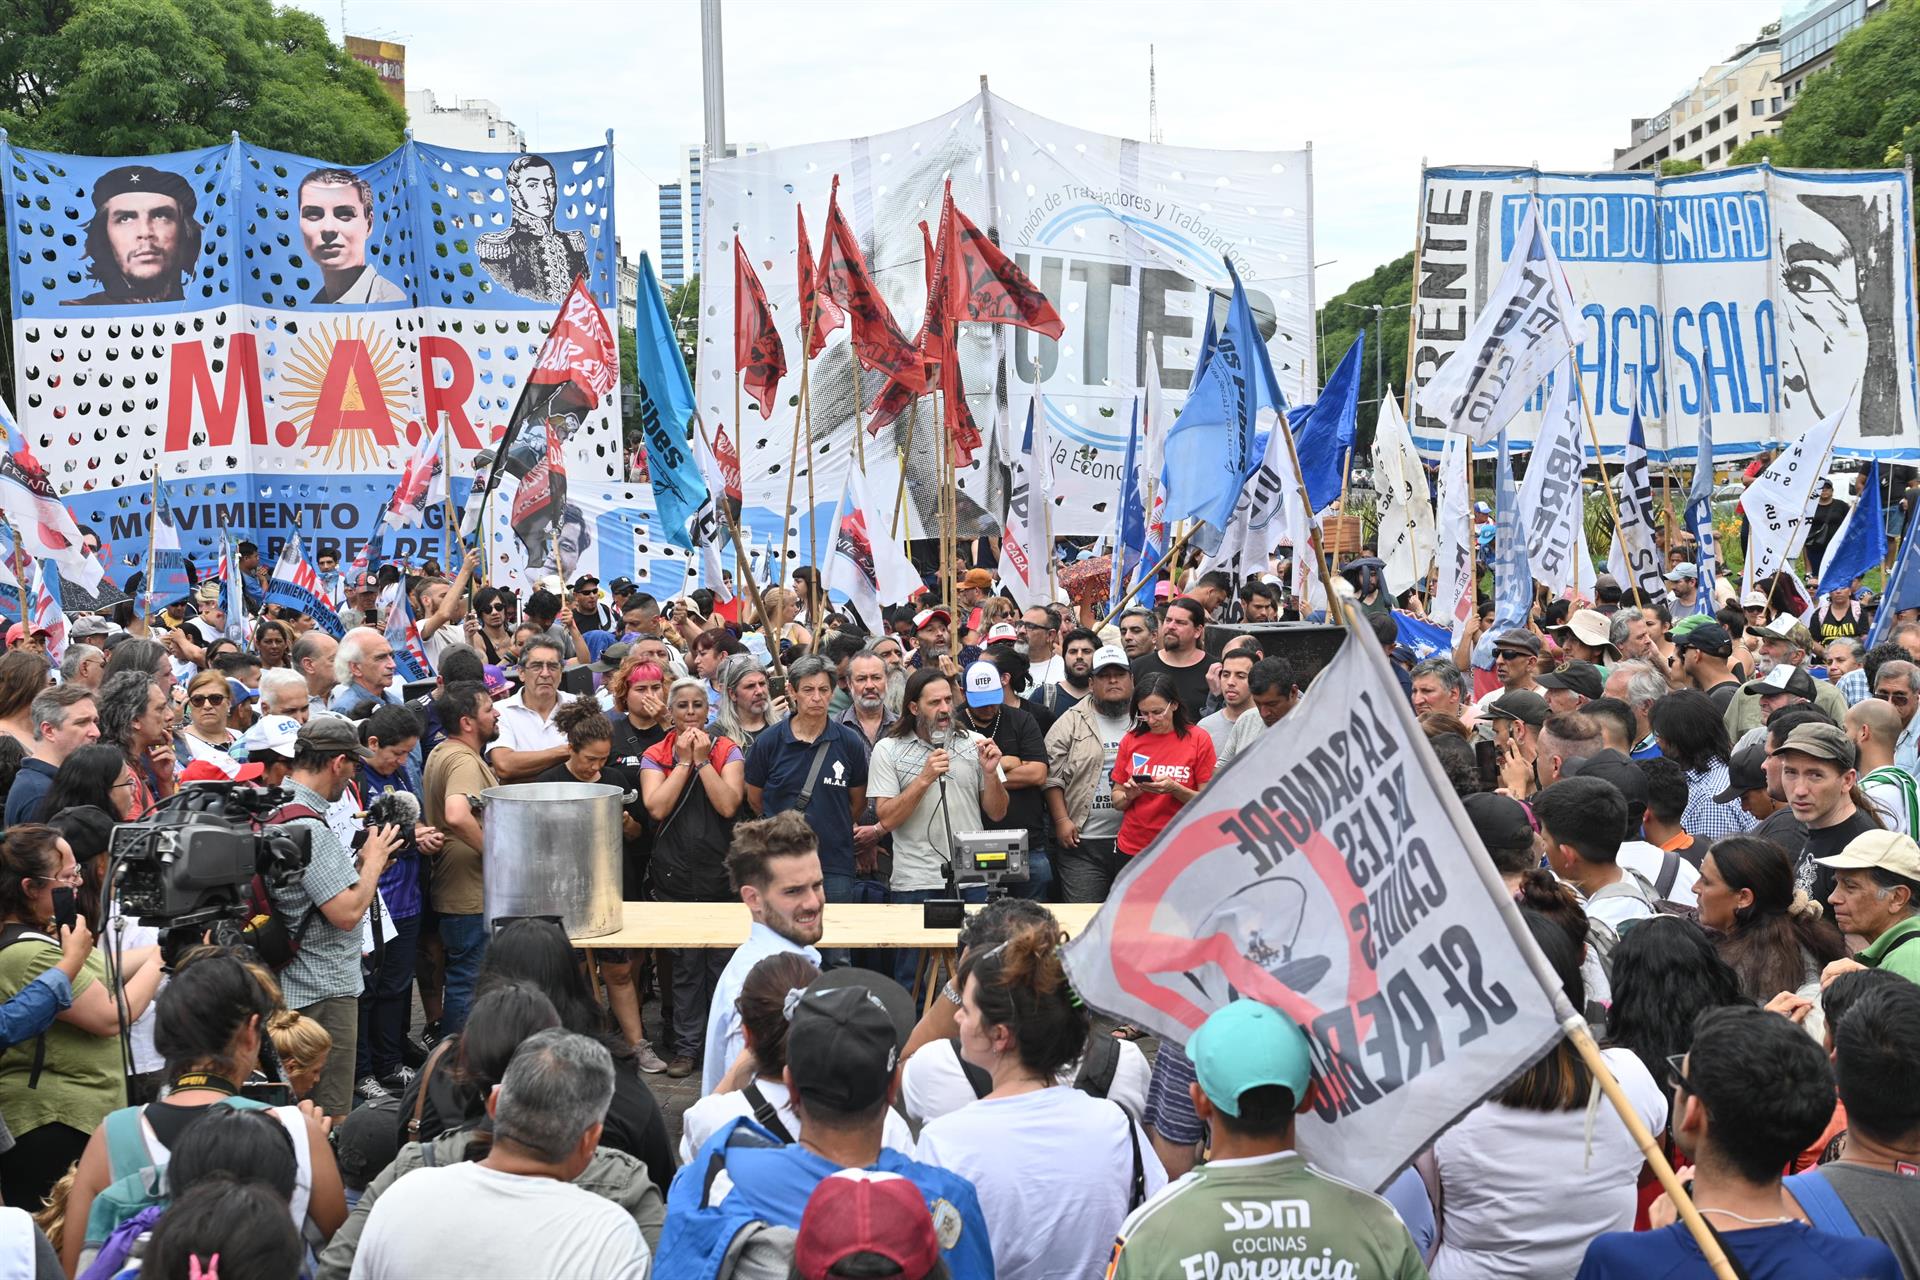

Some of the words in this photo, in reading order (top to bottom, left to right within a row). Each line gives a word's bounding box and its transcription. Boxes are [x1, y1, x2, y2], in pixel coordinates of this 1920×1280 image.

[1017, 202, 1046, 248] Unión
[1044, 190, 1063, 214] de
[1153, 200, 1165, 220] y
[1169, 203, 1256, 282] Trabajadoras
[1673, 299, 1780, 416] SALA
[1052, 439, 1067, 464] la
[2, 463, 54, 493] FRENTE
[1006, 542, 1028, 572] CABA
[975, 677, 991, 686] UTEP
[1143, 764, 1191, 779] LIBRES
[1221, 1199, 1311, 1231] SDM
[1231, 1236, 1307, 1254] COCINAS
[1179, 1248, 1358, 1280] Florencia
